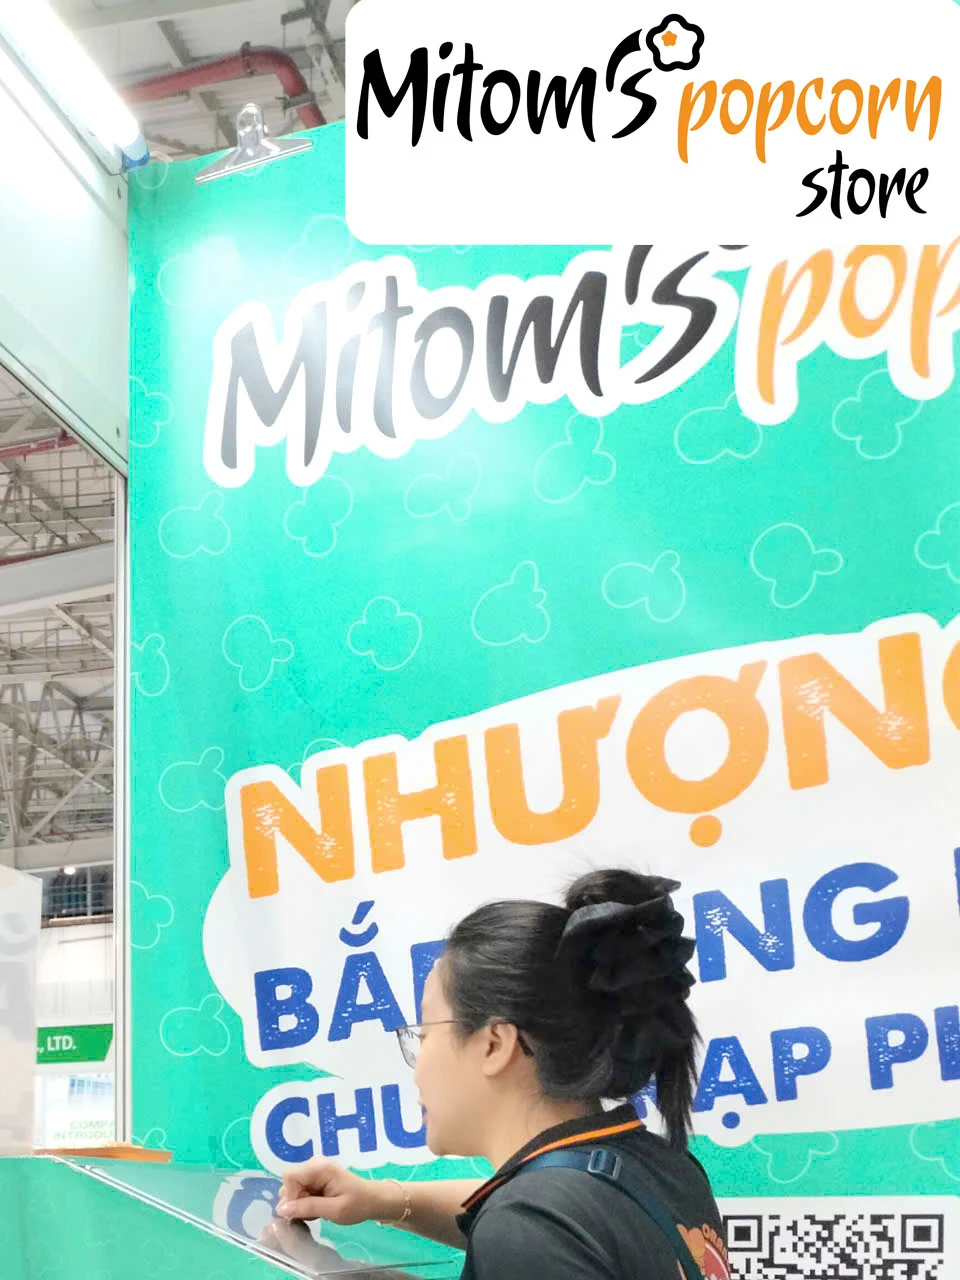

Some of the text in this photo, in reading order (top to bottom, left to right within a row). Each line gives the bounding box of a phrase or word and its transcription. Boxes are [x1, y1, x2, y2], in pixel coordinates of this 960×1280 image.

[239, 631, 960, 900] NHƯỢN
[46, 1034, 77, 1052] LTD.
[265, 1083, 428, 1163] CHU
